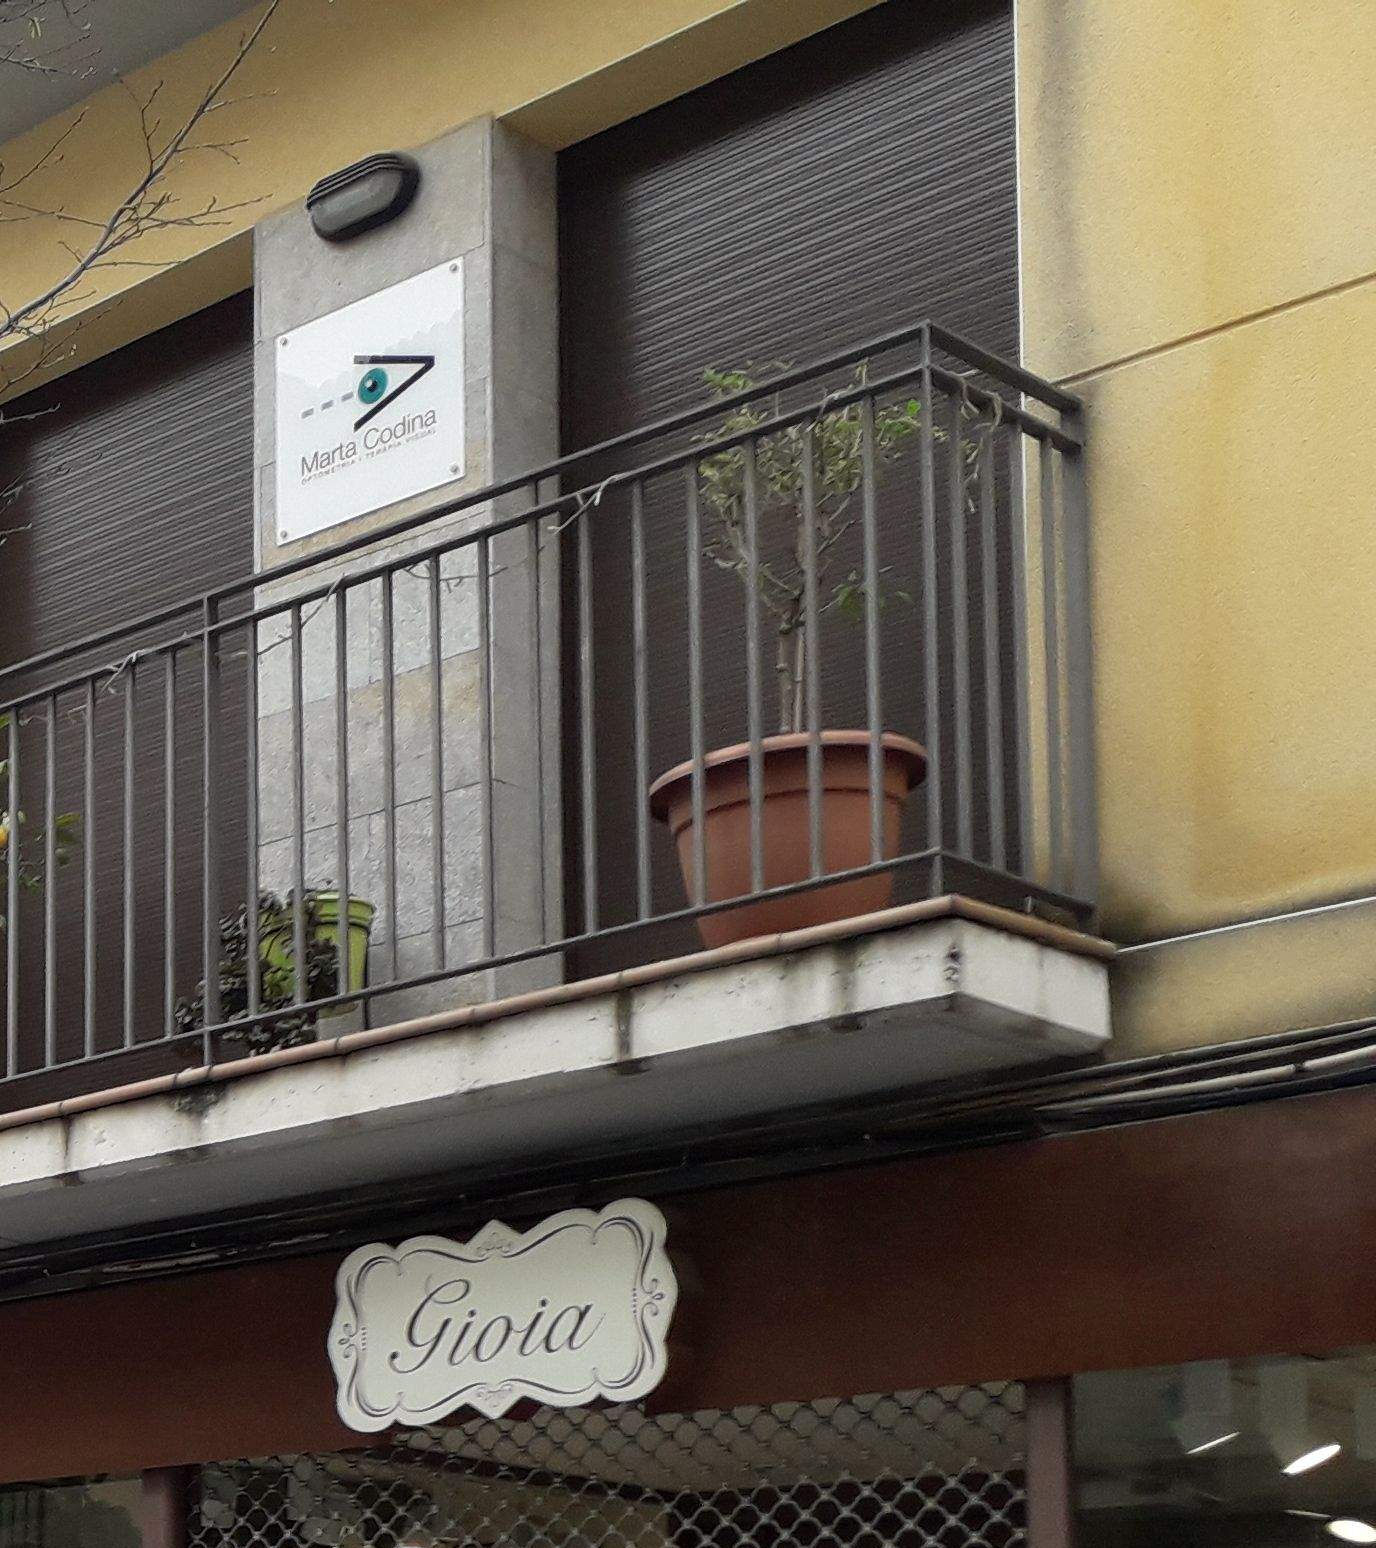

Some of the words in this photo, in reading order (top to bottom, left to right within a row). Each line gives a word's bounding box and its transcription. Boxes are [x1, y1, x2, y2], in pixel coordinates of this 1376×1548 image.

[301, 441, 357, 476] Marta
[363, 409, 437, 450] Codina
[389, 1274, 606, 1374] Gioia
